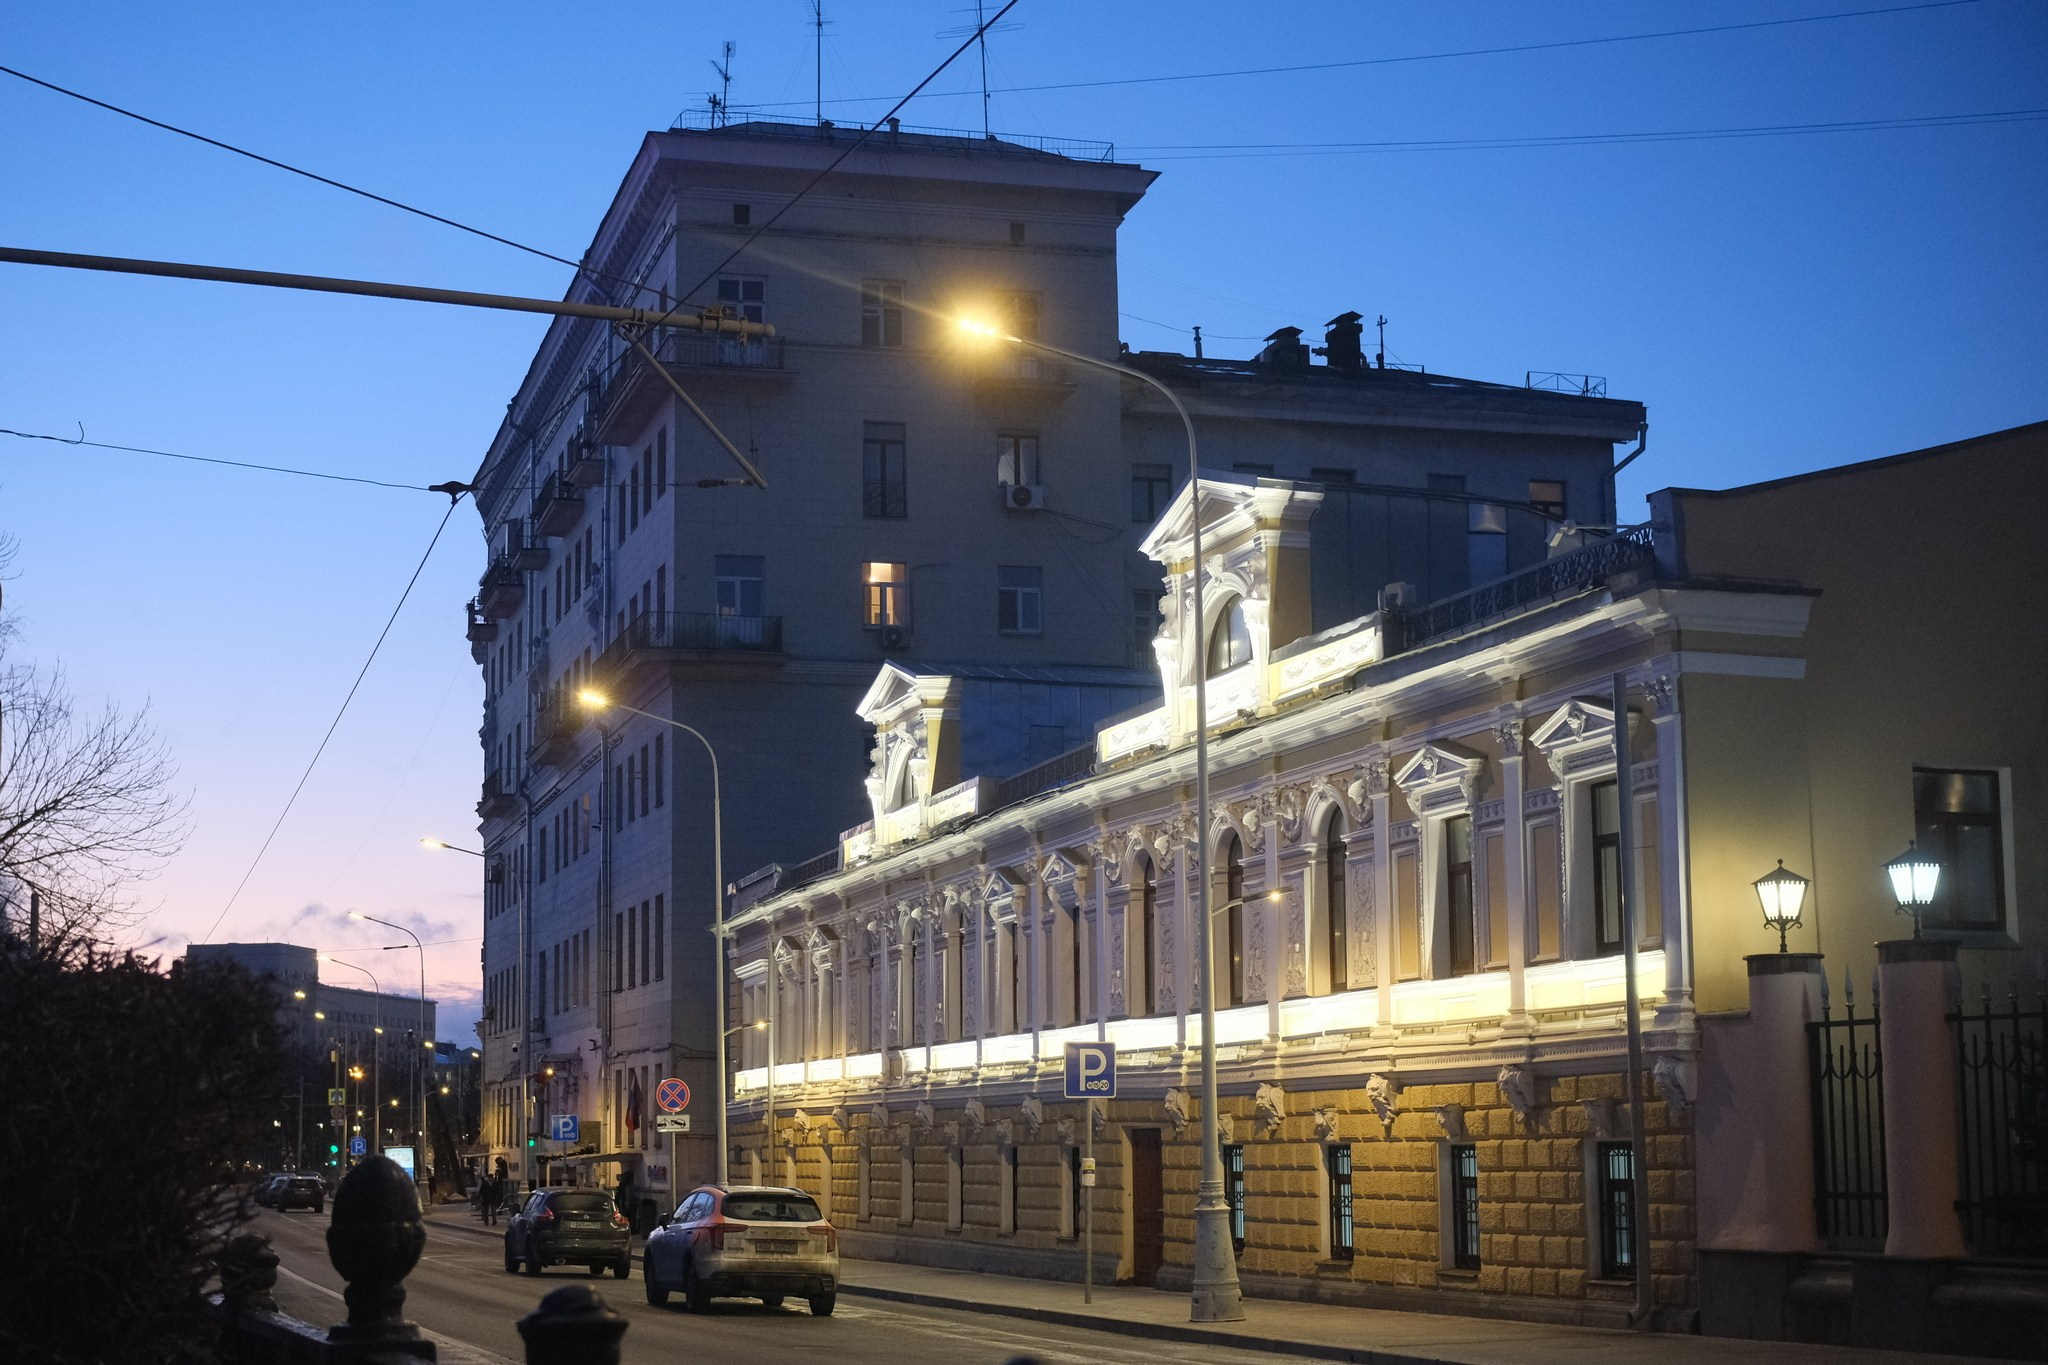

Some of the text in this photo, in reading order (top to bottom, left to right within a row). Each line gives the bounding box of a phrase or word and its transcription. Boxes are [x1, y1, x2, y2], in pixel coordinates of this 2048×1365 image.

[1079, 1048, 1107, 1091] P
[1100, 1081, 1108, 1089] 20
[559, 1118, 574, 1139] P
[355, 1141, 364, 1153] P
